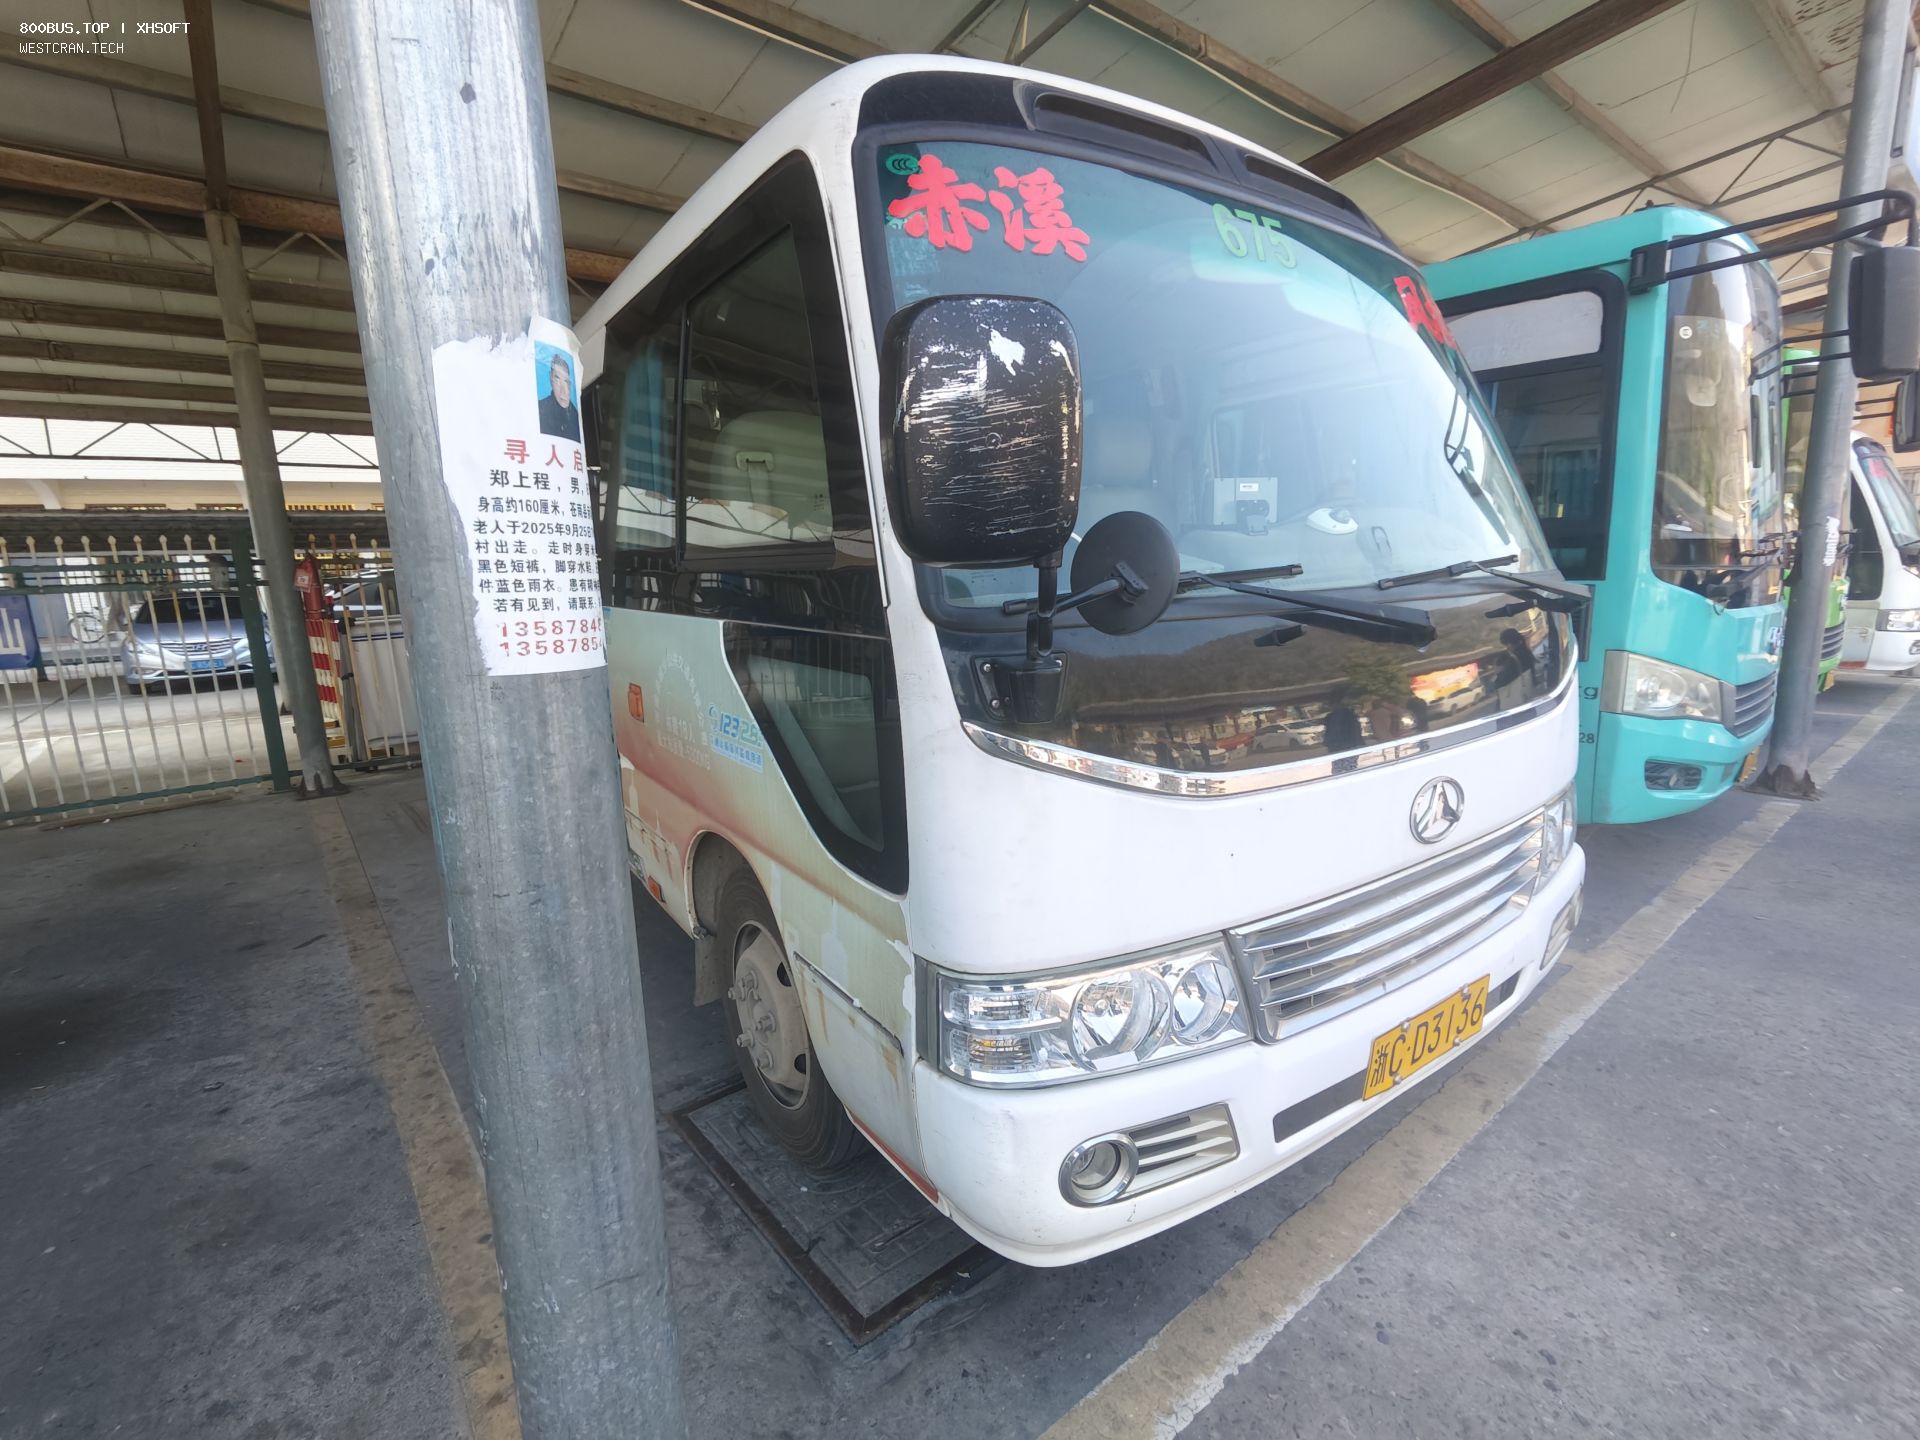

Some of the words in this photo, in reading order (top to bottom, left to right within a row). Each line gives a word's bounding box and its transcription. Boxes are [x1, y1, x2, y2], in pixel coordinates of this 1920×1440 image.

[887, 153, 1090, 262] 赤溪
[1211, 203, 1297, 269] 675
[499, 637, 602, 657] 1358785
